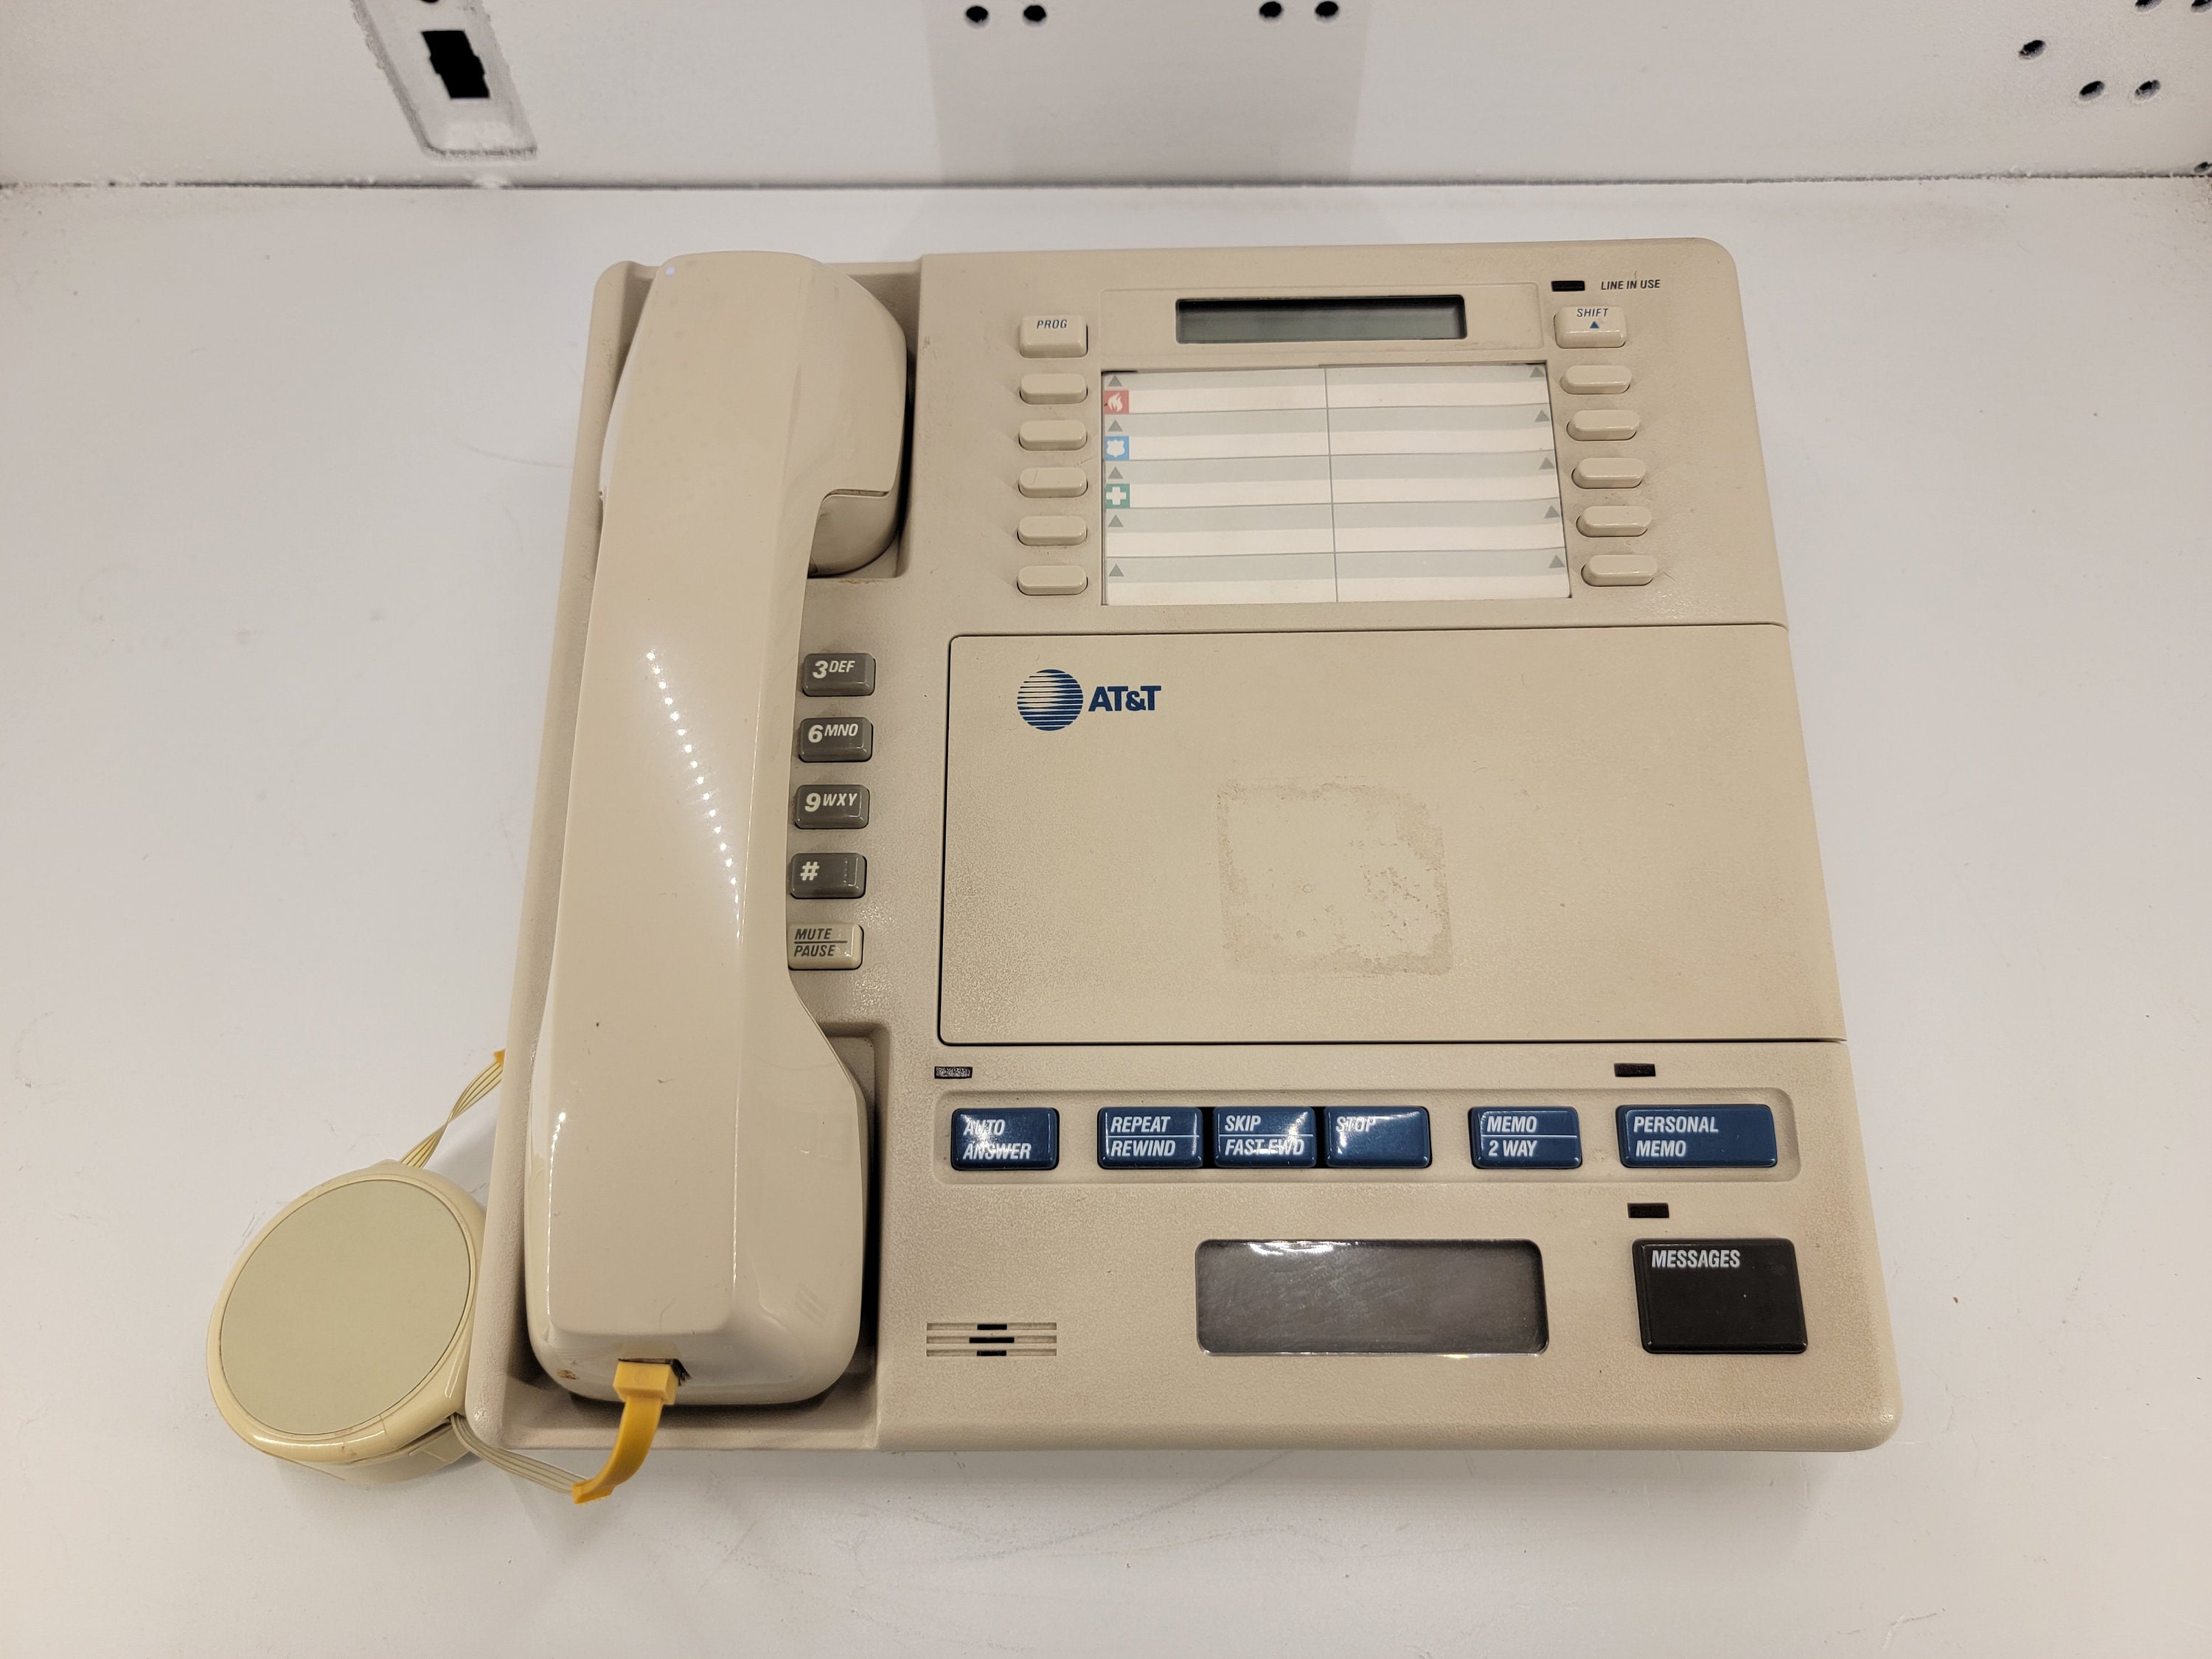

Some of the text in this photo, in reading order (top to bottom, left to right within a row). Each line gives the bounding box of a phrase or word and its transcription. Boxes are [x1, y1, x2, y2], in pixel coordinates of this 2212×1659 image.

[1601, 279, 1660, 290] LINE IN USE
[1576, 308, 1609, 317] SHIFT
[1037, 319, 1068, 329] PROG
[1088, 686, 1161, 712] AT&T
[795, 928, 832, 940] MUTE
[794, 945, 835, 957] PAUSE
[963, 1119, 1006, 1135] AUTO
[1110, 1116, 1171, 1133] REPEAT
[1225, 1115, 1261, 1132] SKIP
[1335, 1116, 1377, 1132] STOP
[1486, 1116, 1537, 1133] MEMO
[1633, 1116, 1719, 1133] PERSONAL
[962, 1143, 1032, 1160] ANSWER
[1110, 1140, 1176, 1157] REWIND
[1225, 1138, 1304, 1155] FAST FWD
[1488, 1140, 1537, 1156] 2 WAY
[1635, 1140, 1687, 1157] MEMO
[1651, 1250, 1741, 1268] MESSAGES
